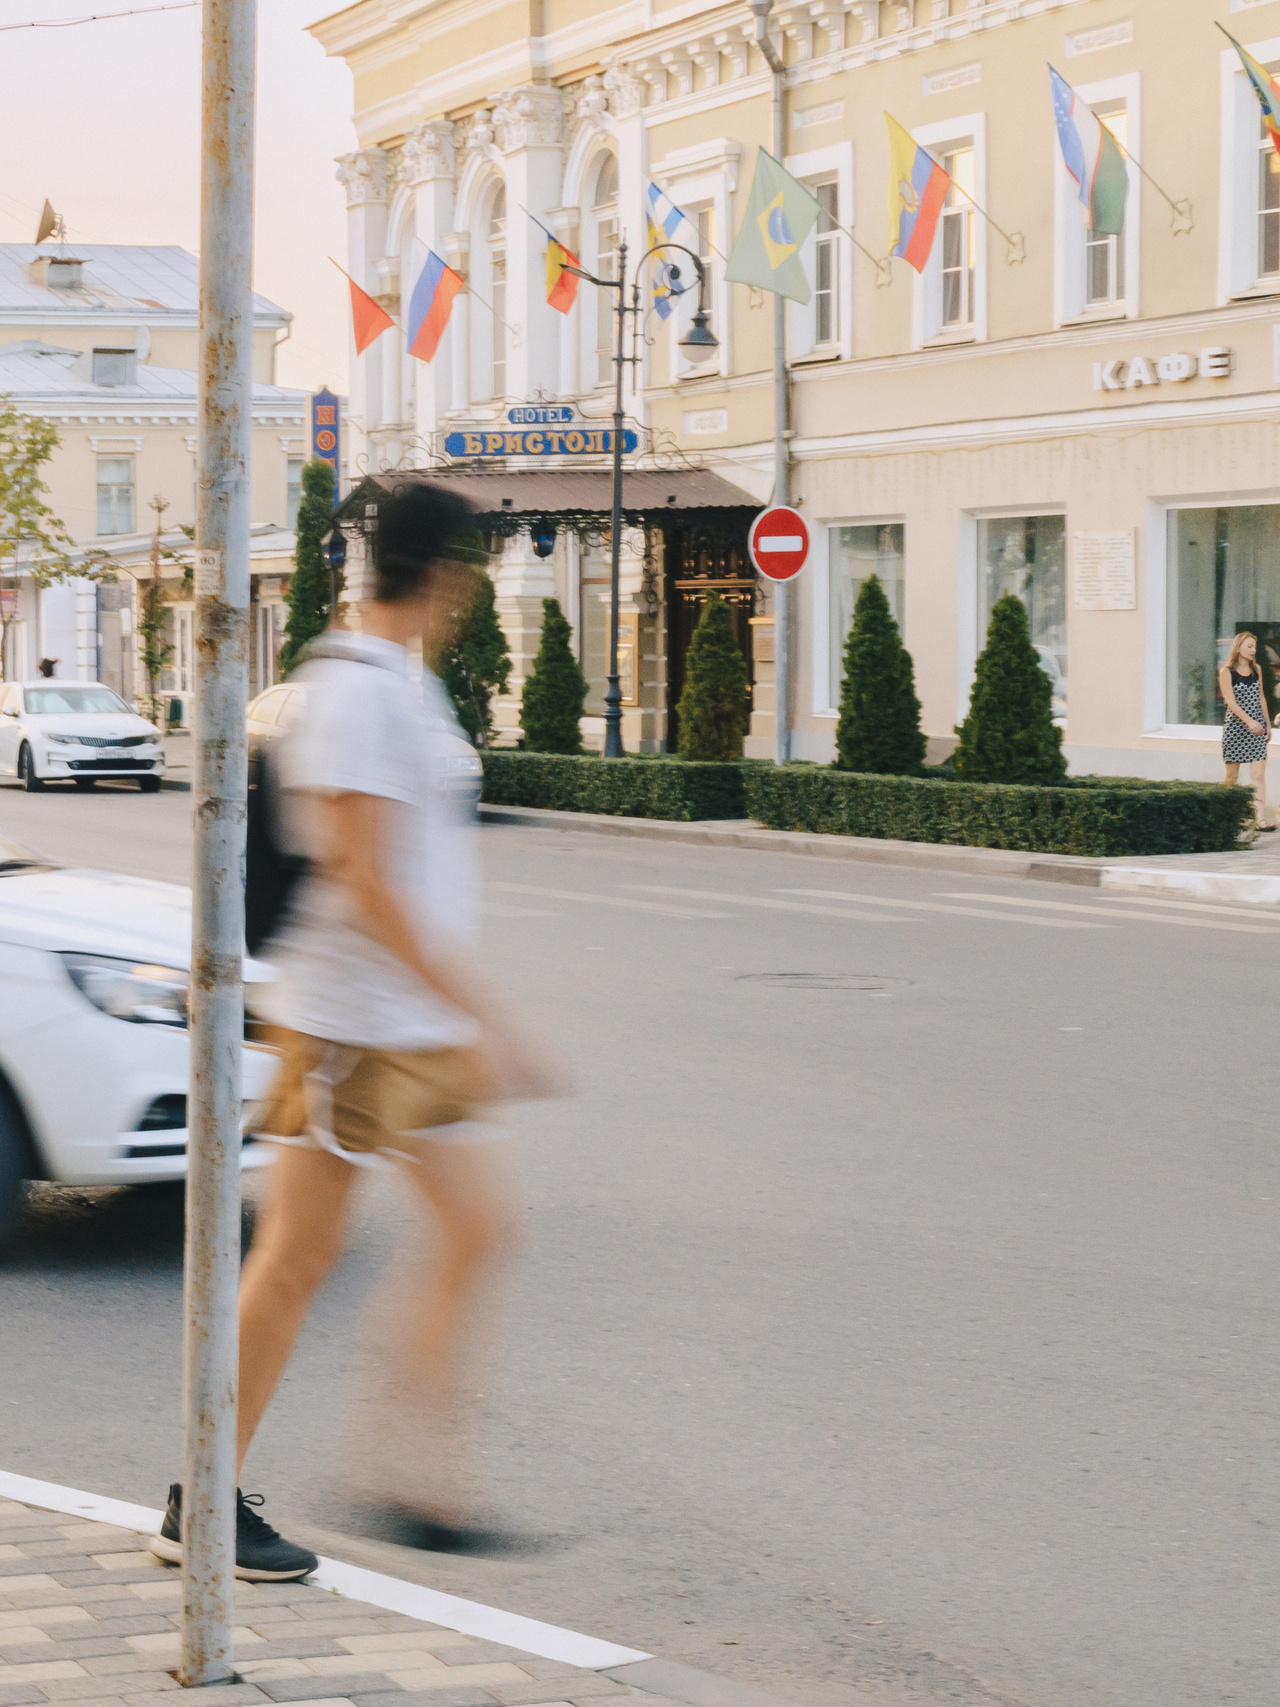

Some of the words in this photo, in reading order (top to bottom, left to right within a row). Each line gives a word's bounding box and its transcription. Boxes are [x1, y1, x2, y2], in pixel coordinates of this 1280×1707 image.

[1092, 346, 1234, 391] КАФЕ
[513, 408, 570, 423] HOTEL
[462, 431, 627, 455] БРИСТОЛЬ
